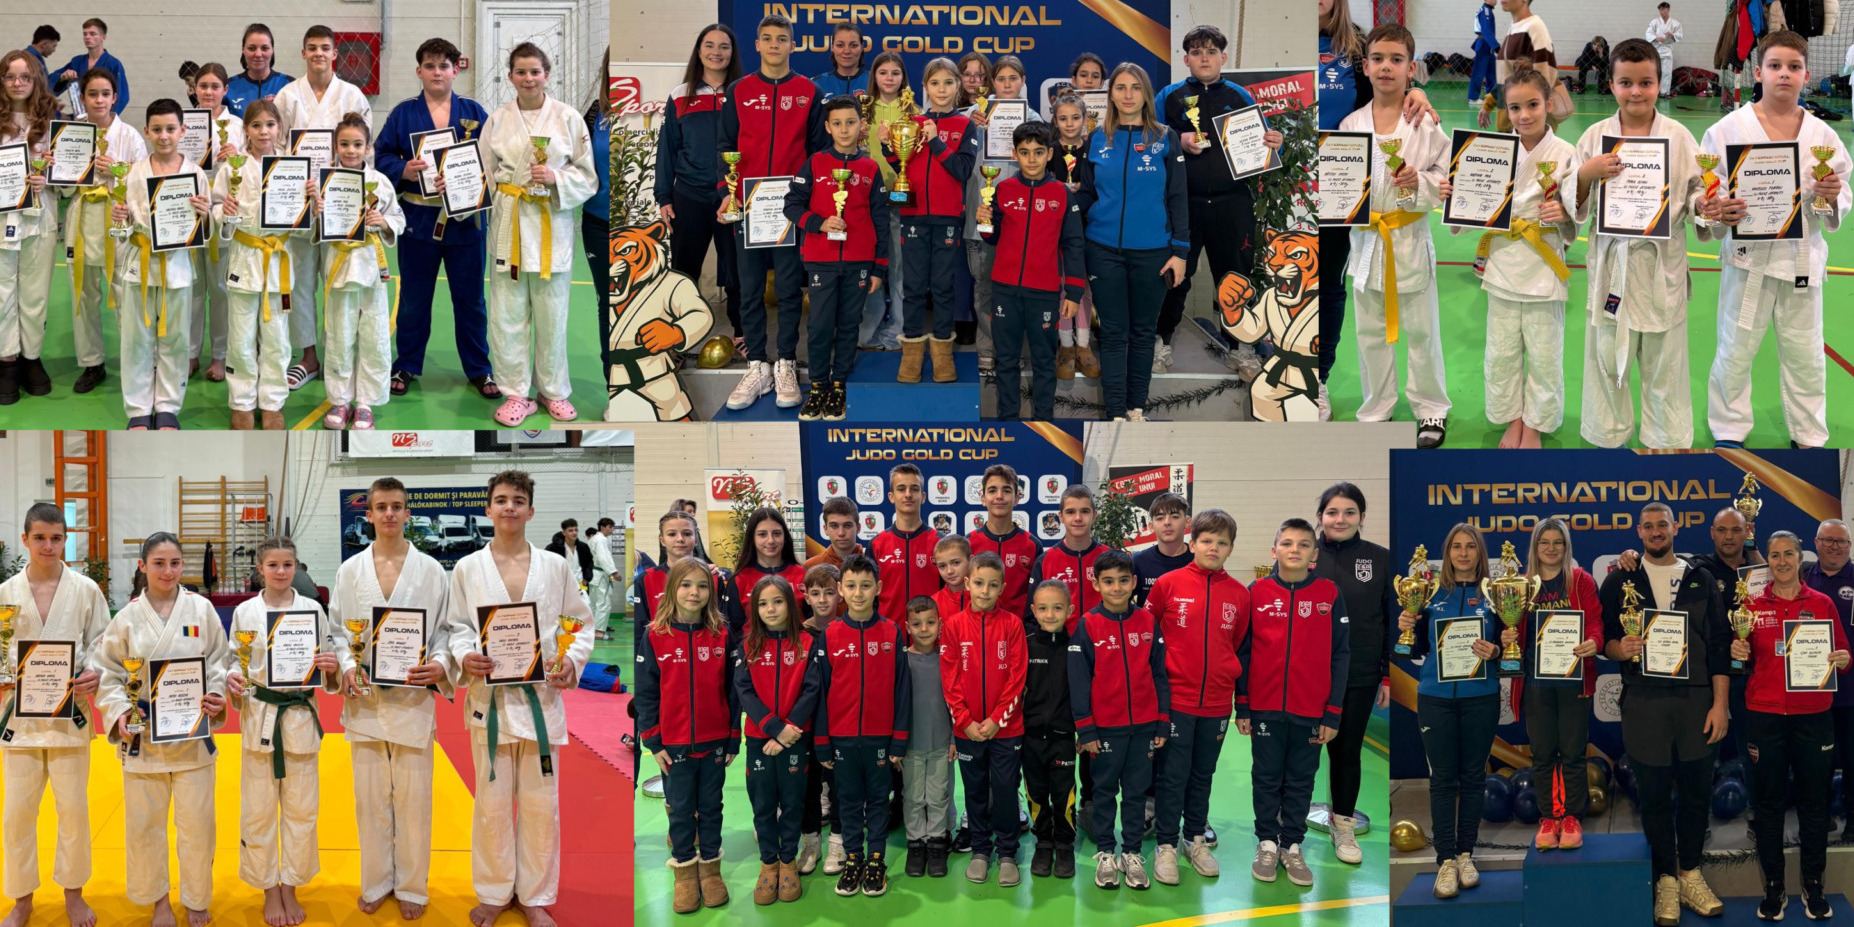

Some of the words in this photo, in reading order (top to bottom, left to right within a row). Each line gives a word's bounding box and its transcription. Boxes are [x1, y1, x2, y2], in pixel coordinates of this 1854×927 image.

[764, 3, 1062, 26] INTERNATIONAL
[794, 35, 872, 53] JUO
[882, 35, 963, 53] GOLD
[973, 36, 1035, 54] CUP
[1229, 122, 1260, 136] DIPLOMA
[447, 159, 477, 169] DIPLOMA
[1320, 155, 1364, 163] DIPLOMA
[1466, 155, 1509, 166] DIPLOMA
[1744, 168, 1791, 177] DIPLOMA
[329, 186, 360, 194] DIPLOMA
[160, 192, 194, 202] DIPLOMA
[827, 428, 1015, 443] INTERNATIONAL
[846, 449, 896, 461] JUDO
[902, 449, 953, 461] GOLD
[959, 448, 999, 460] CUP
[1138, 471, 1164, 484] MORAL
[1428, 479, 1731, 505] INTERNATIONAL
[1145, 577, 1157, 586] 100
[384, 627, 420, 635] DIPLOMA
[493, 623, 531, 631] DIPLOMA
[1653, 627, 1682, 635] DIPLOMA
[163, 678, 200, 687] DIPLOMA
